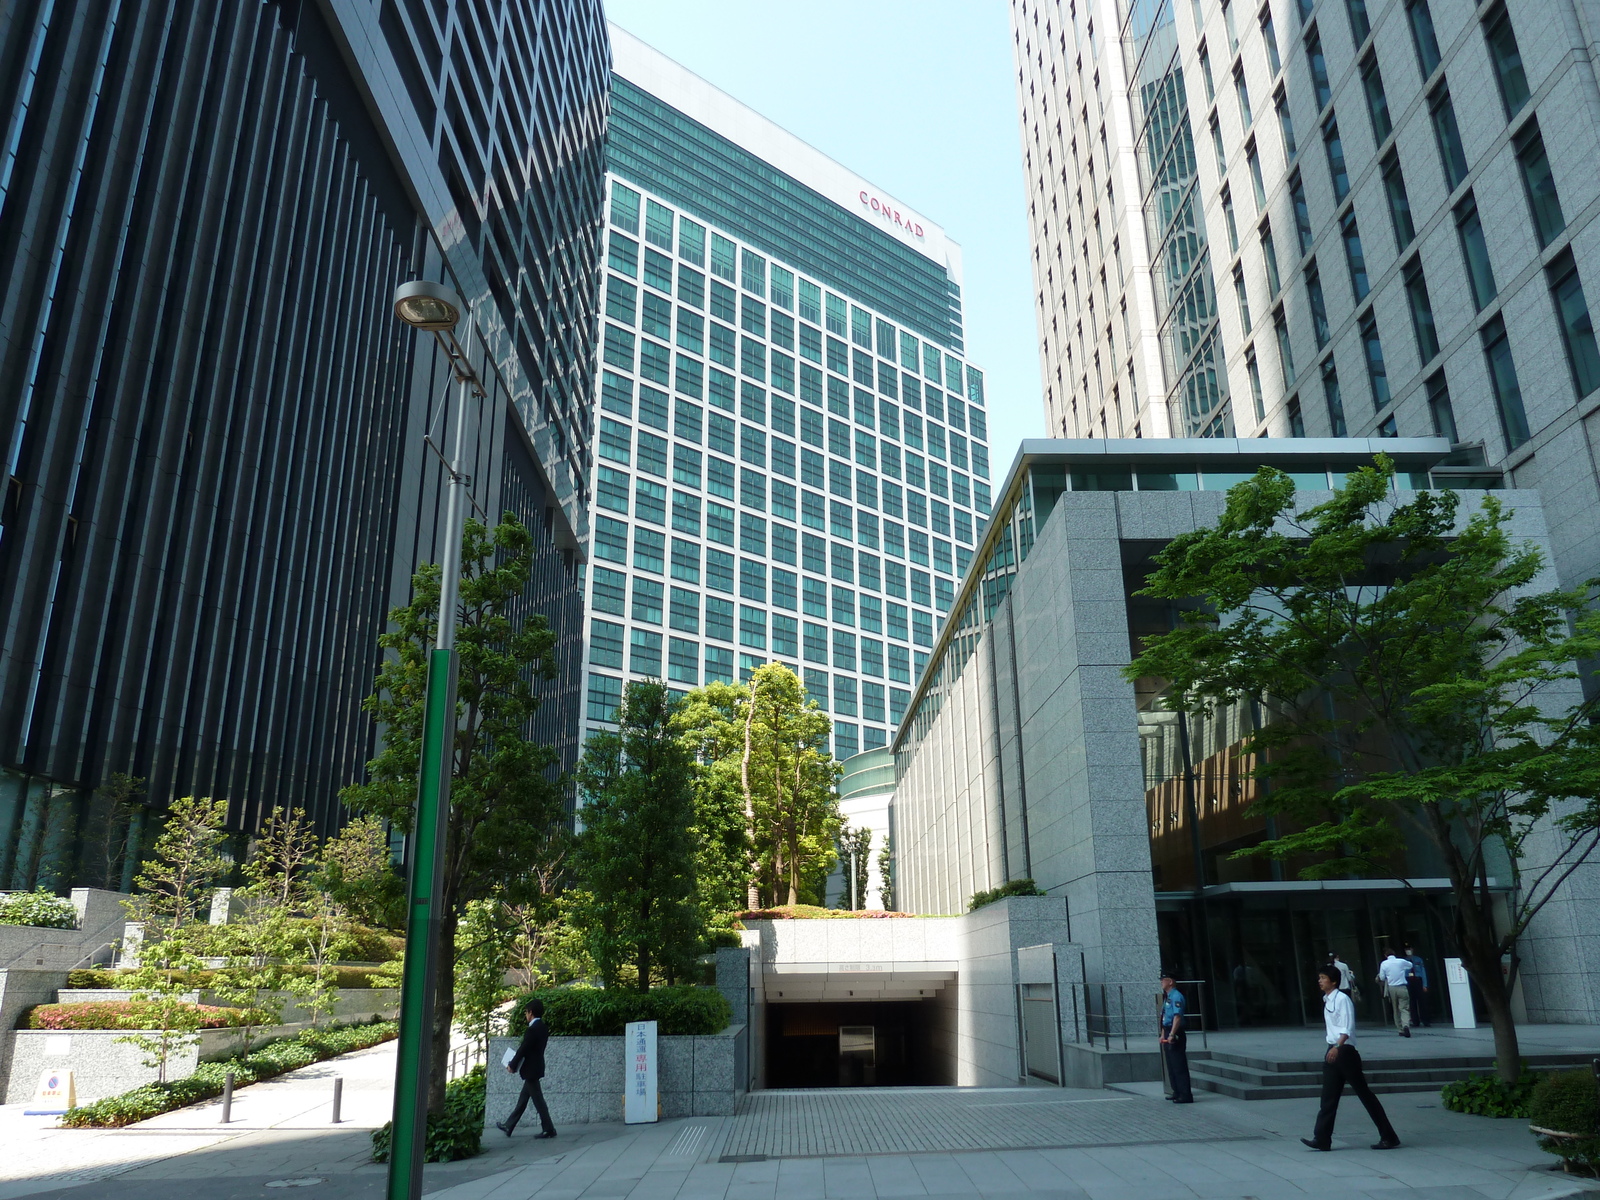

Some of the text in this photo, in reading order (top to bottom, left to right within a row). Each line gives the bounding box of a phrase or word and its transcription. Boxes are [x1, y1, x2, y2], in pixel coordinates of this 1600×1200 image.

[859, 190, 924, 237] CONRAD
[635, 1023, 647, 1096] 日本通運専用駐車場
